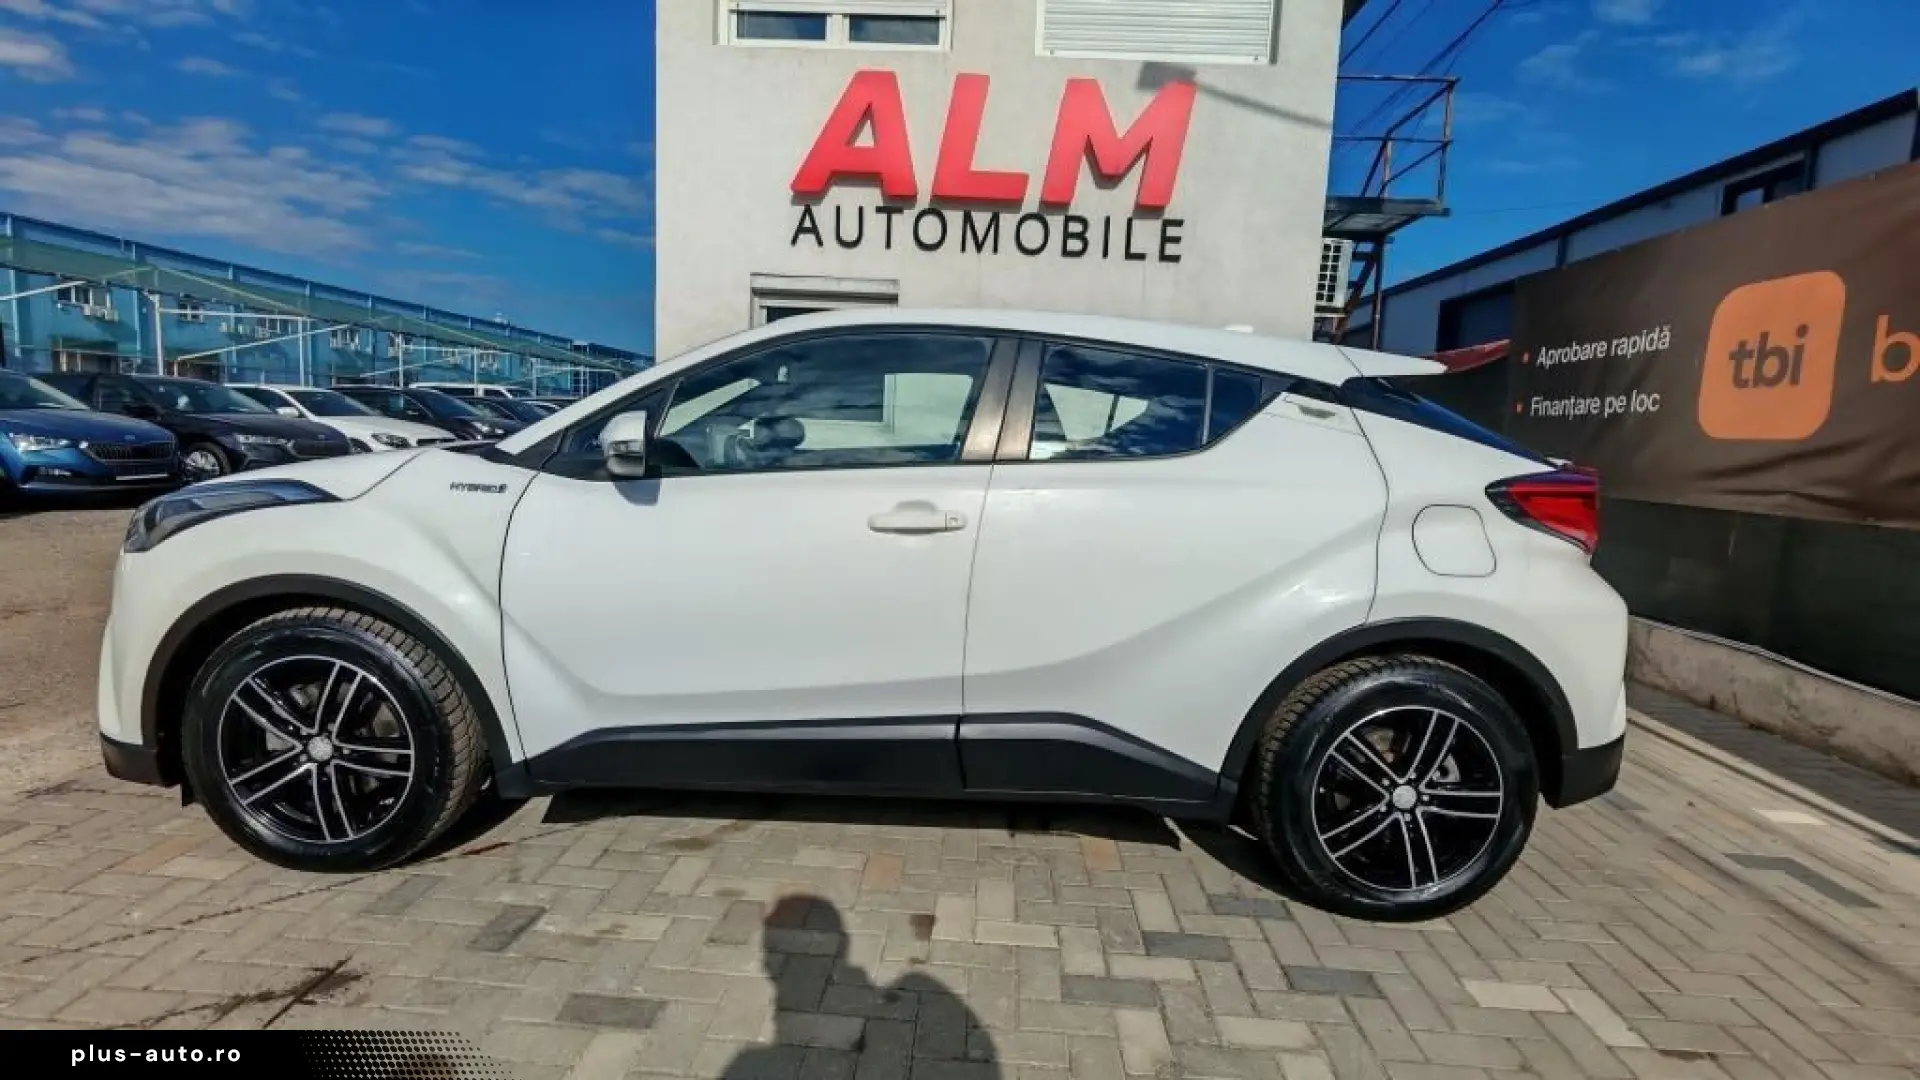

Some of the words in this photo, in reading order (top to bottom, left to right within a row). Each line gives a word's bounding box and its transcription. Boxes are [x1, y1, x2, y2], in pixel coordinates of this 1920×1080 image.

[790, 70, 1198, 209] ALM
[790, 204, 1185, 263] AUTOMOBILE
[1536, 340, 1608, 368] Aprobare
[1610, 323, 1671, 359] rapidă
[1729, 323, 1809, 389] tbi
[1604, 396, 1627, 418] pe
[1631, 390, 1660, 413] loc
